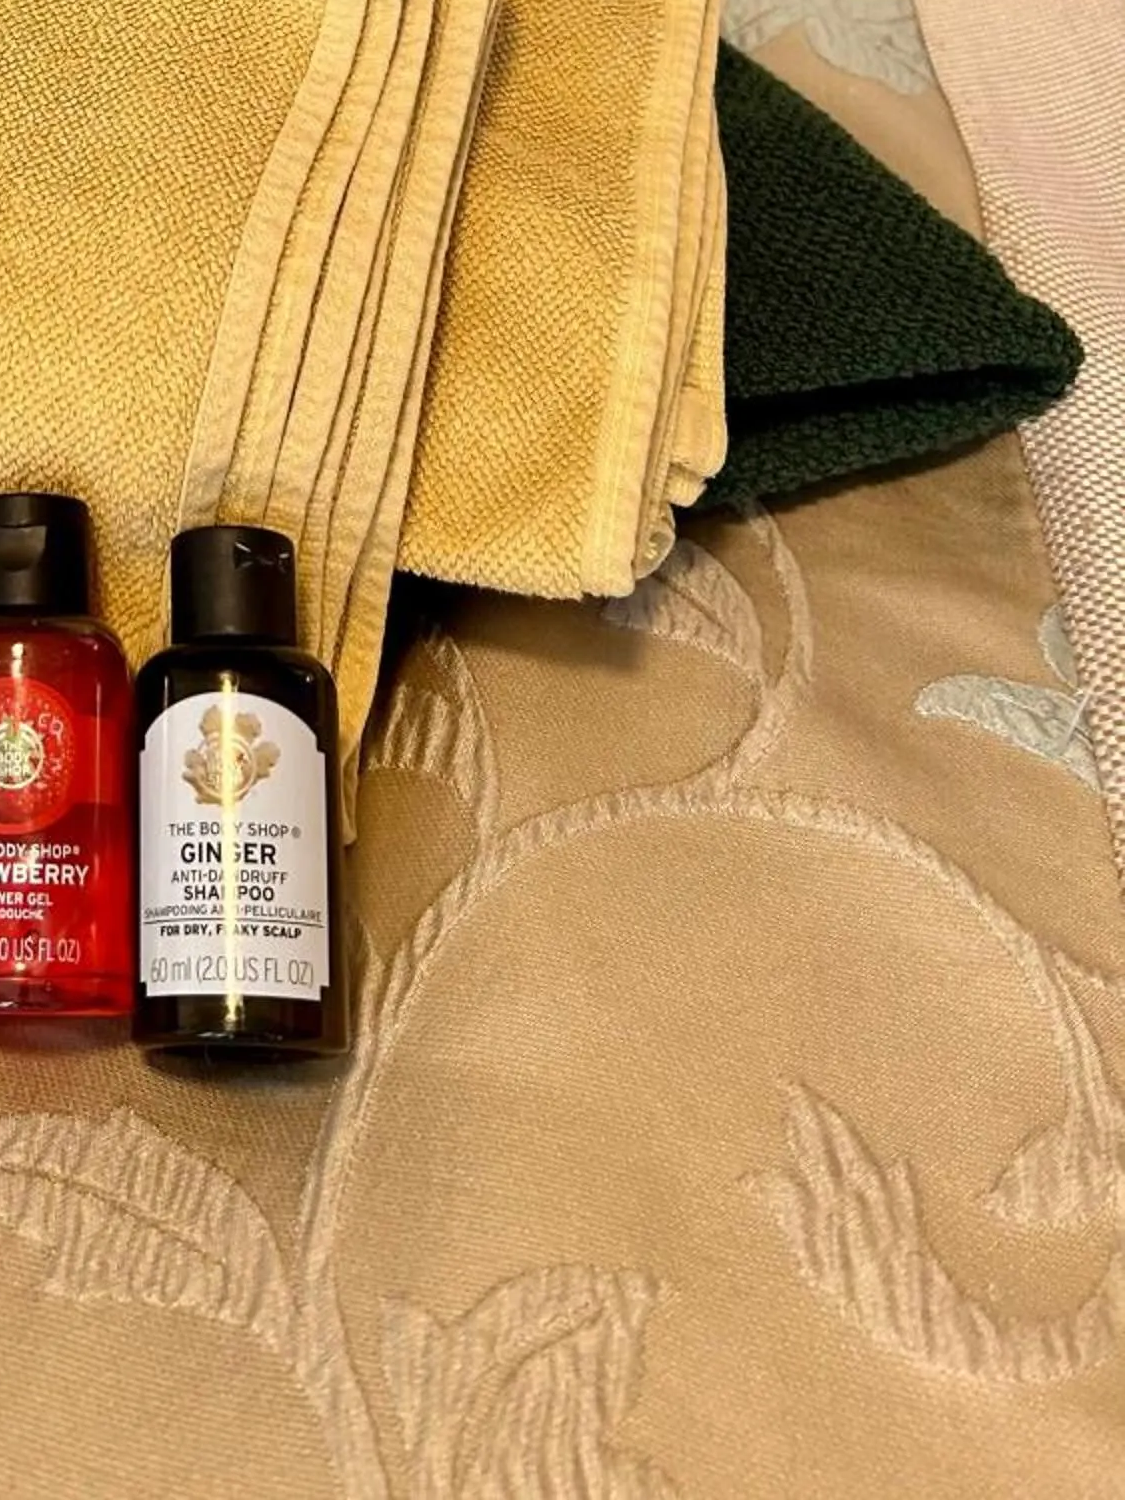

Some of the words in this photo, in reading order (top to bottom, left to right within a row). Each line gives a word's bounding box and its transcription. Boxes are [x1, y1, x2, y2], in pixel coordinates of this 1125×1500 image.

[169, 822, 196, 837] THE
[200, 821, 244, 837] BOY
[171, 869, 288, 885] ANTI-DDRUFF
[27, 893, 54, 907] GEL
[183, 884, 275, 902] SHAPOO
[144, 903, 208, 919] SHAMPOOING
[210, 904, 323, 923] AI-PELLICULAIRE
[160, 924, 181, 937] FOR
[183, 924, 213, 937] DRY,
[215, 924, 259, 937] FAKY
[262, 925, 302, 939] SCALP
[13, 937, 35, 962] US
[38, 938, 55, 962] FL
[56, 939, 82, 964] OZ)
[150, 957, 169, 984] 60
[171, 956, 192, 982] ml
[195, 955, 229, 985] (2.0
[233, 955, 260, 982] US
[263, 957, 284, 984] FL
[288, 958, 315, 988] OZ)
